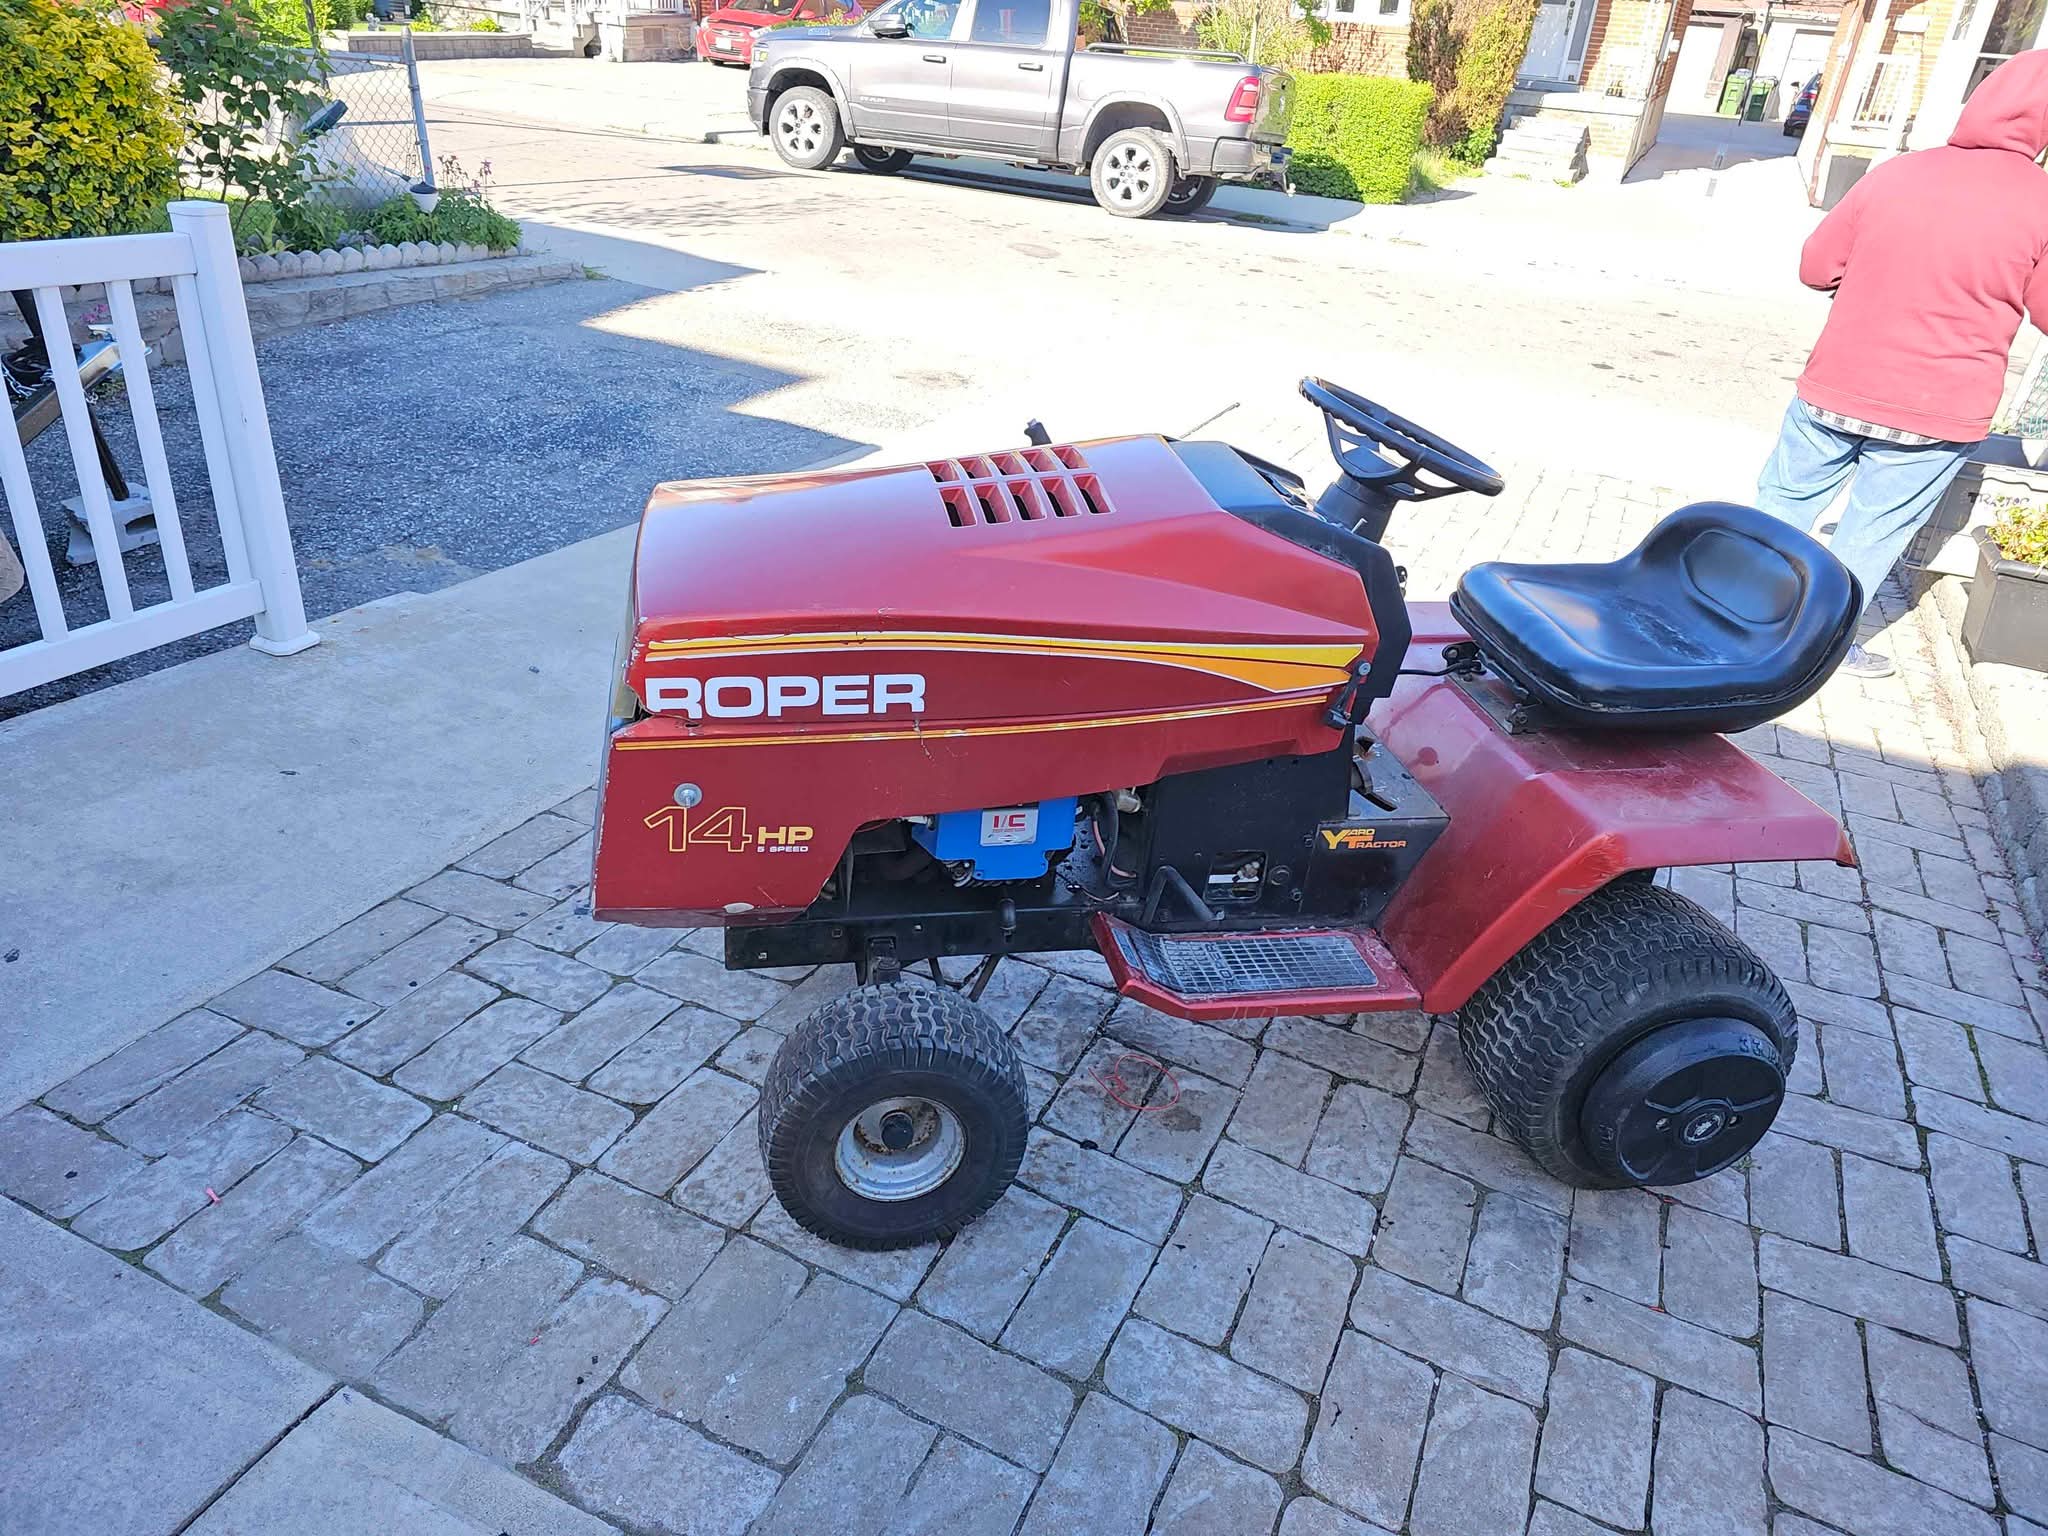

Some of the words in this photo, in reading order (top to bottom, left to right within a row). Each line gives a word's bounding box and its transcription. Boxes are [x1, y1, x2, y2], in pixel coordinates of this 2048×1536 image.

[645, 674, 926, 719] ROPER
[643, 806, 753, 852] 14
[757, 826, 814, 845] HP
[1320, 828, 1375, 850] YARD
[1341, 835, 1407, 849] TRACTOR
